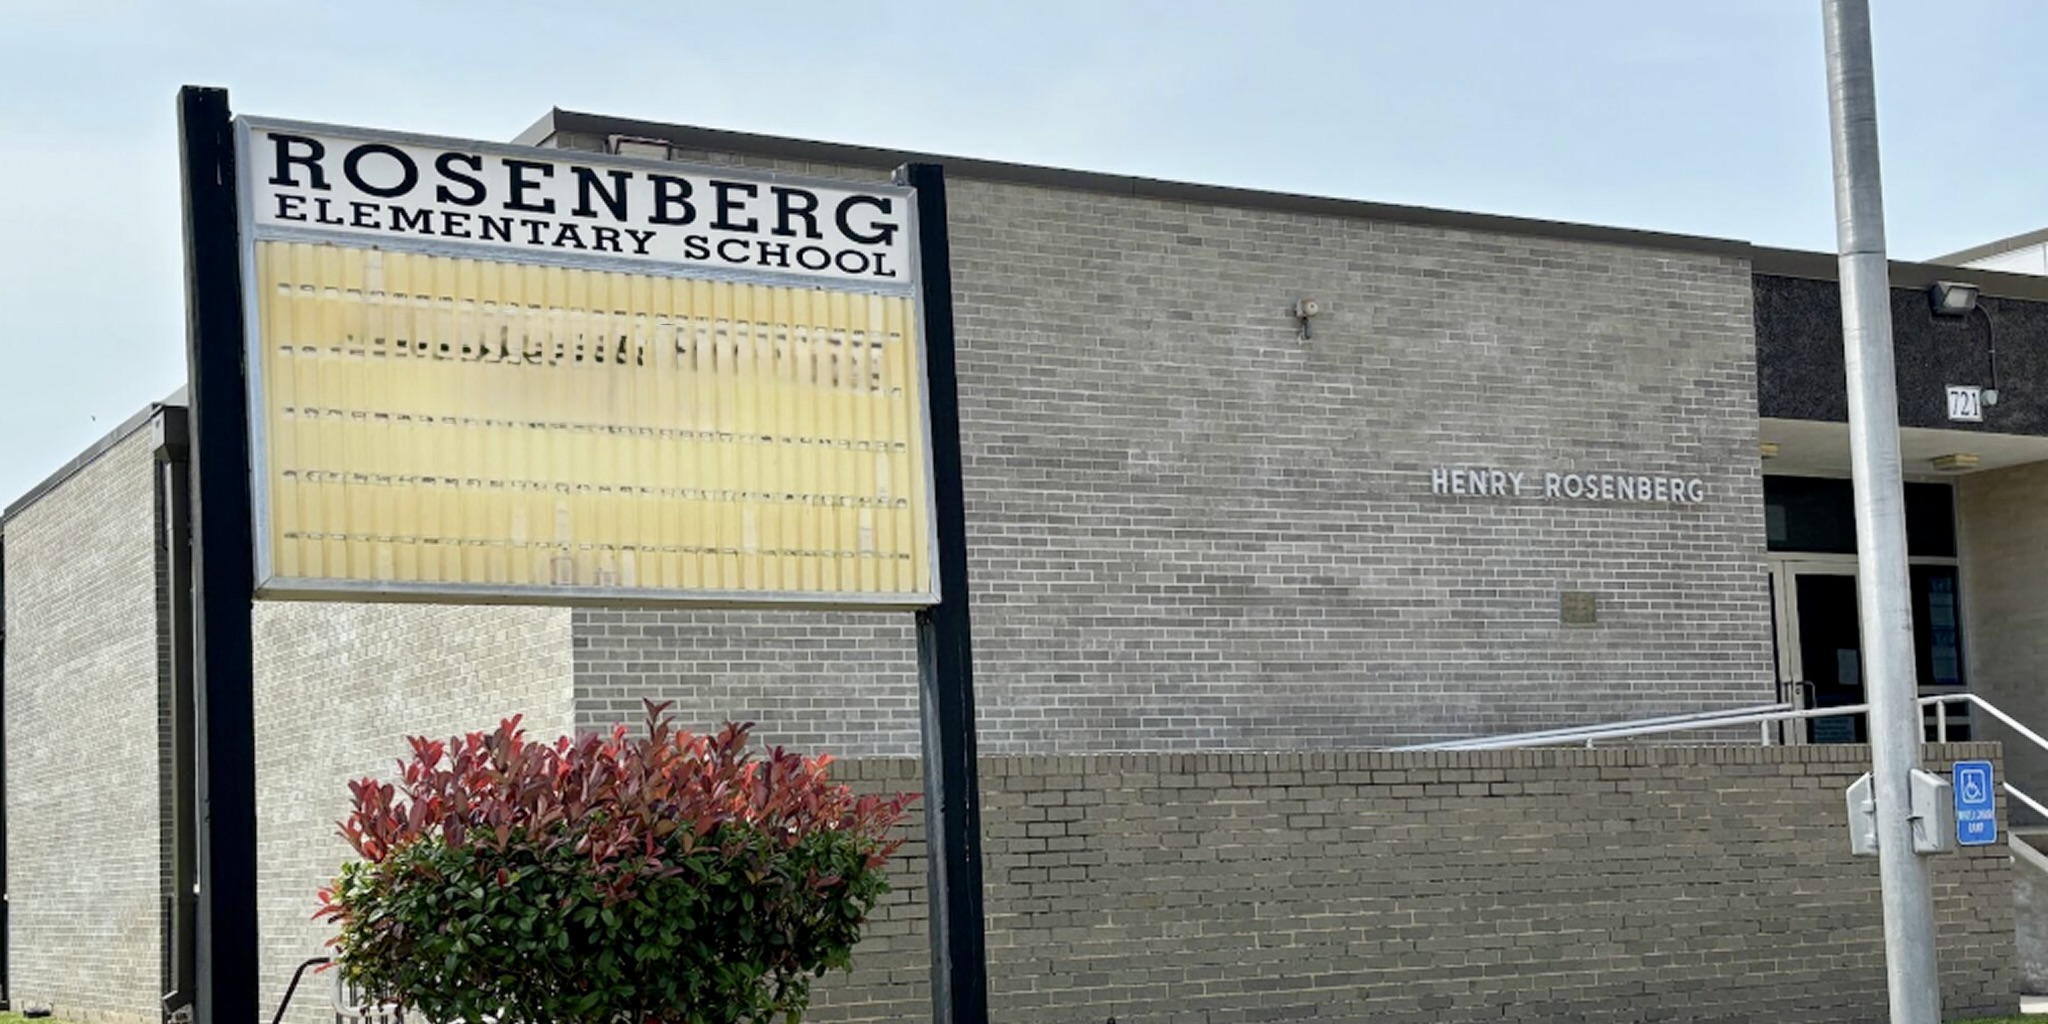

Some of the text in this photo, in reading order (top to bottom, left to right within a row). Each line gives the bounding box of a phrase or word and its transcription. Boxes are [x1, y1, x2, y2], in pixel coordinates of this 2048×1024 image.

[267, 132, 899, 246] ROSENBERG
[275, 194, 897, 278] ELEMENTARY SCHOOL
[1950, 391, 1979, 416] 721
[1432, 468, 1704, 502] HENRY ROSENBERG
